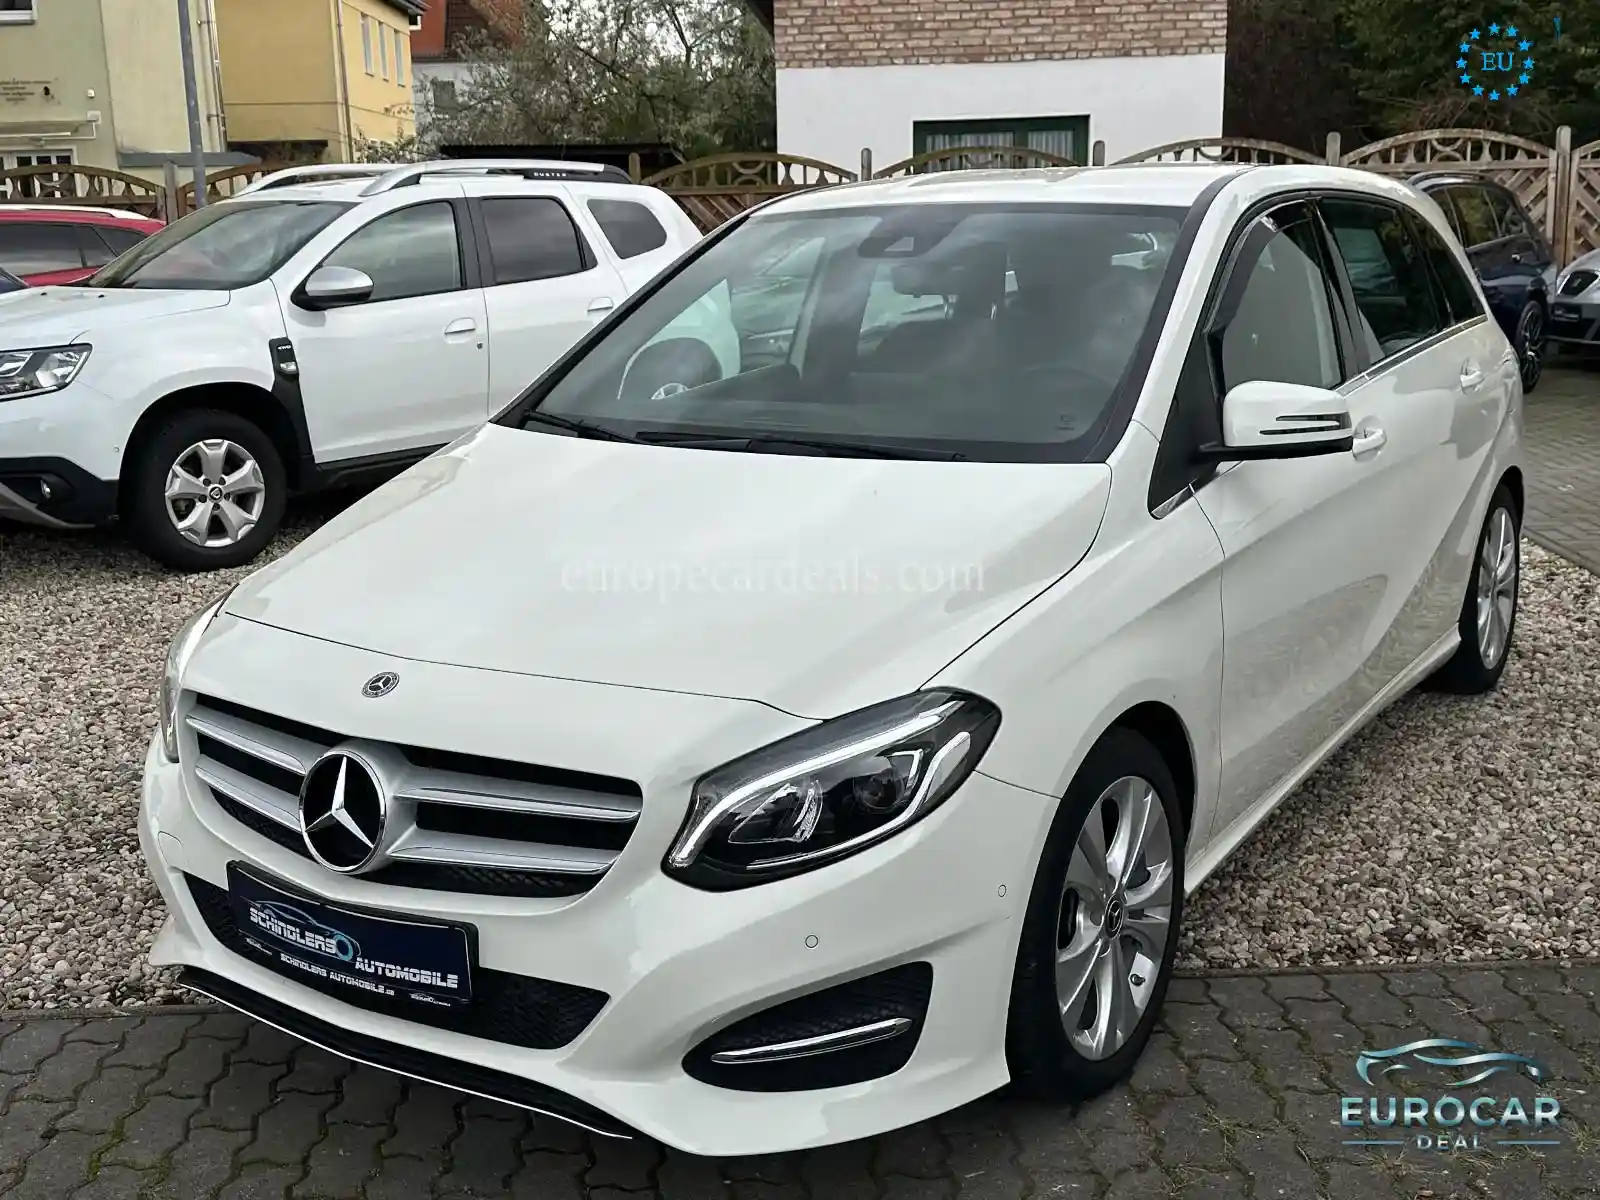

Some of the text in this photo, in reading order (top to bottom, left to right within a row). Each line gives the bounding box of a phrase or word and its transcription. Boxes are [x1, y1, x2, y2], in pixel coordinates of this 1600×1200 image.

[249, 906, 337, 954] SCHINDLERS
[280, 952, 328, 977] SCHINDLERS
[354, 956, 459, 989] AUTOMOBILE
